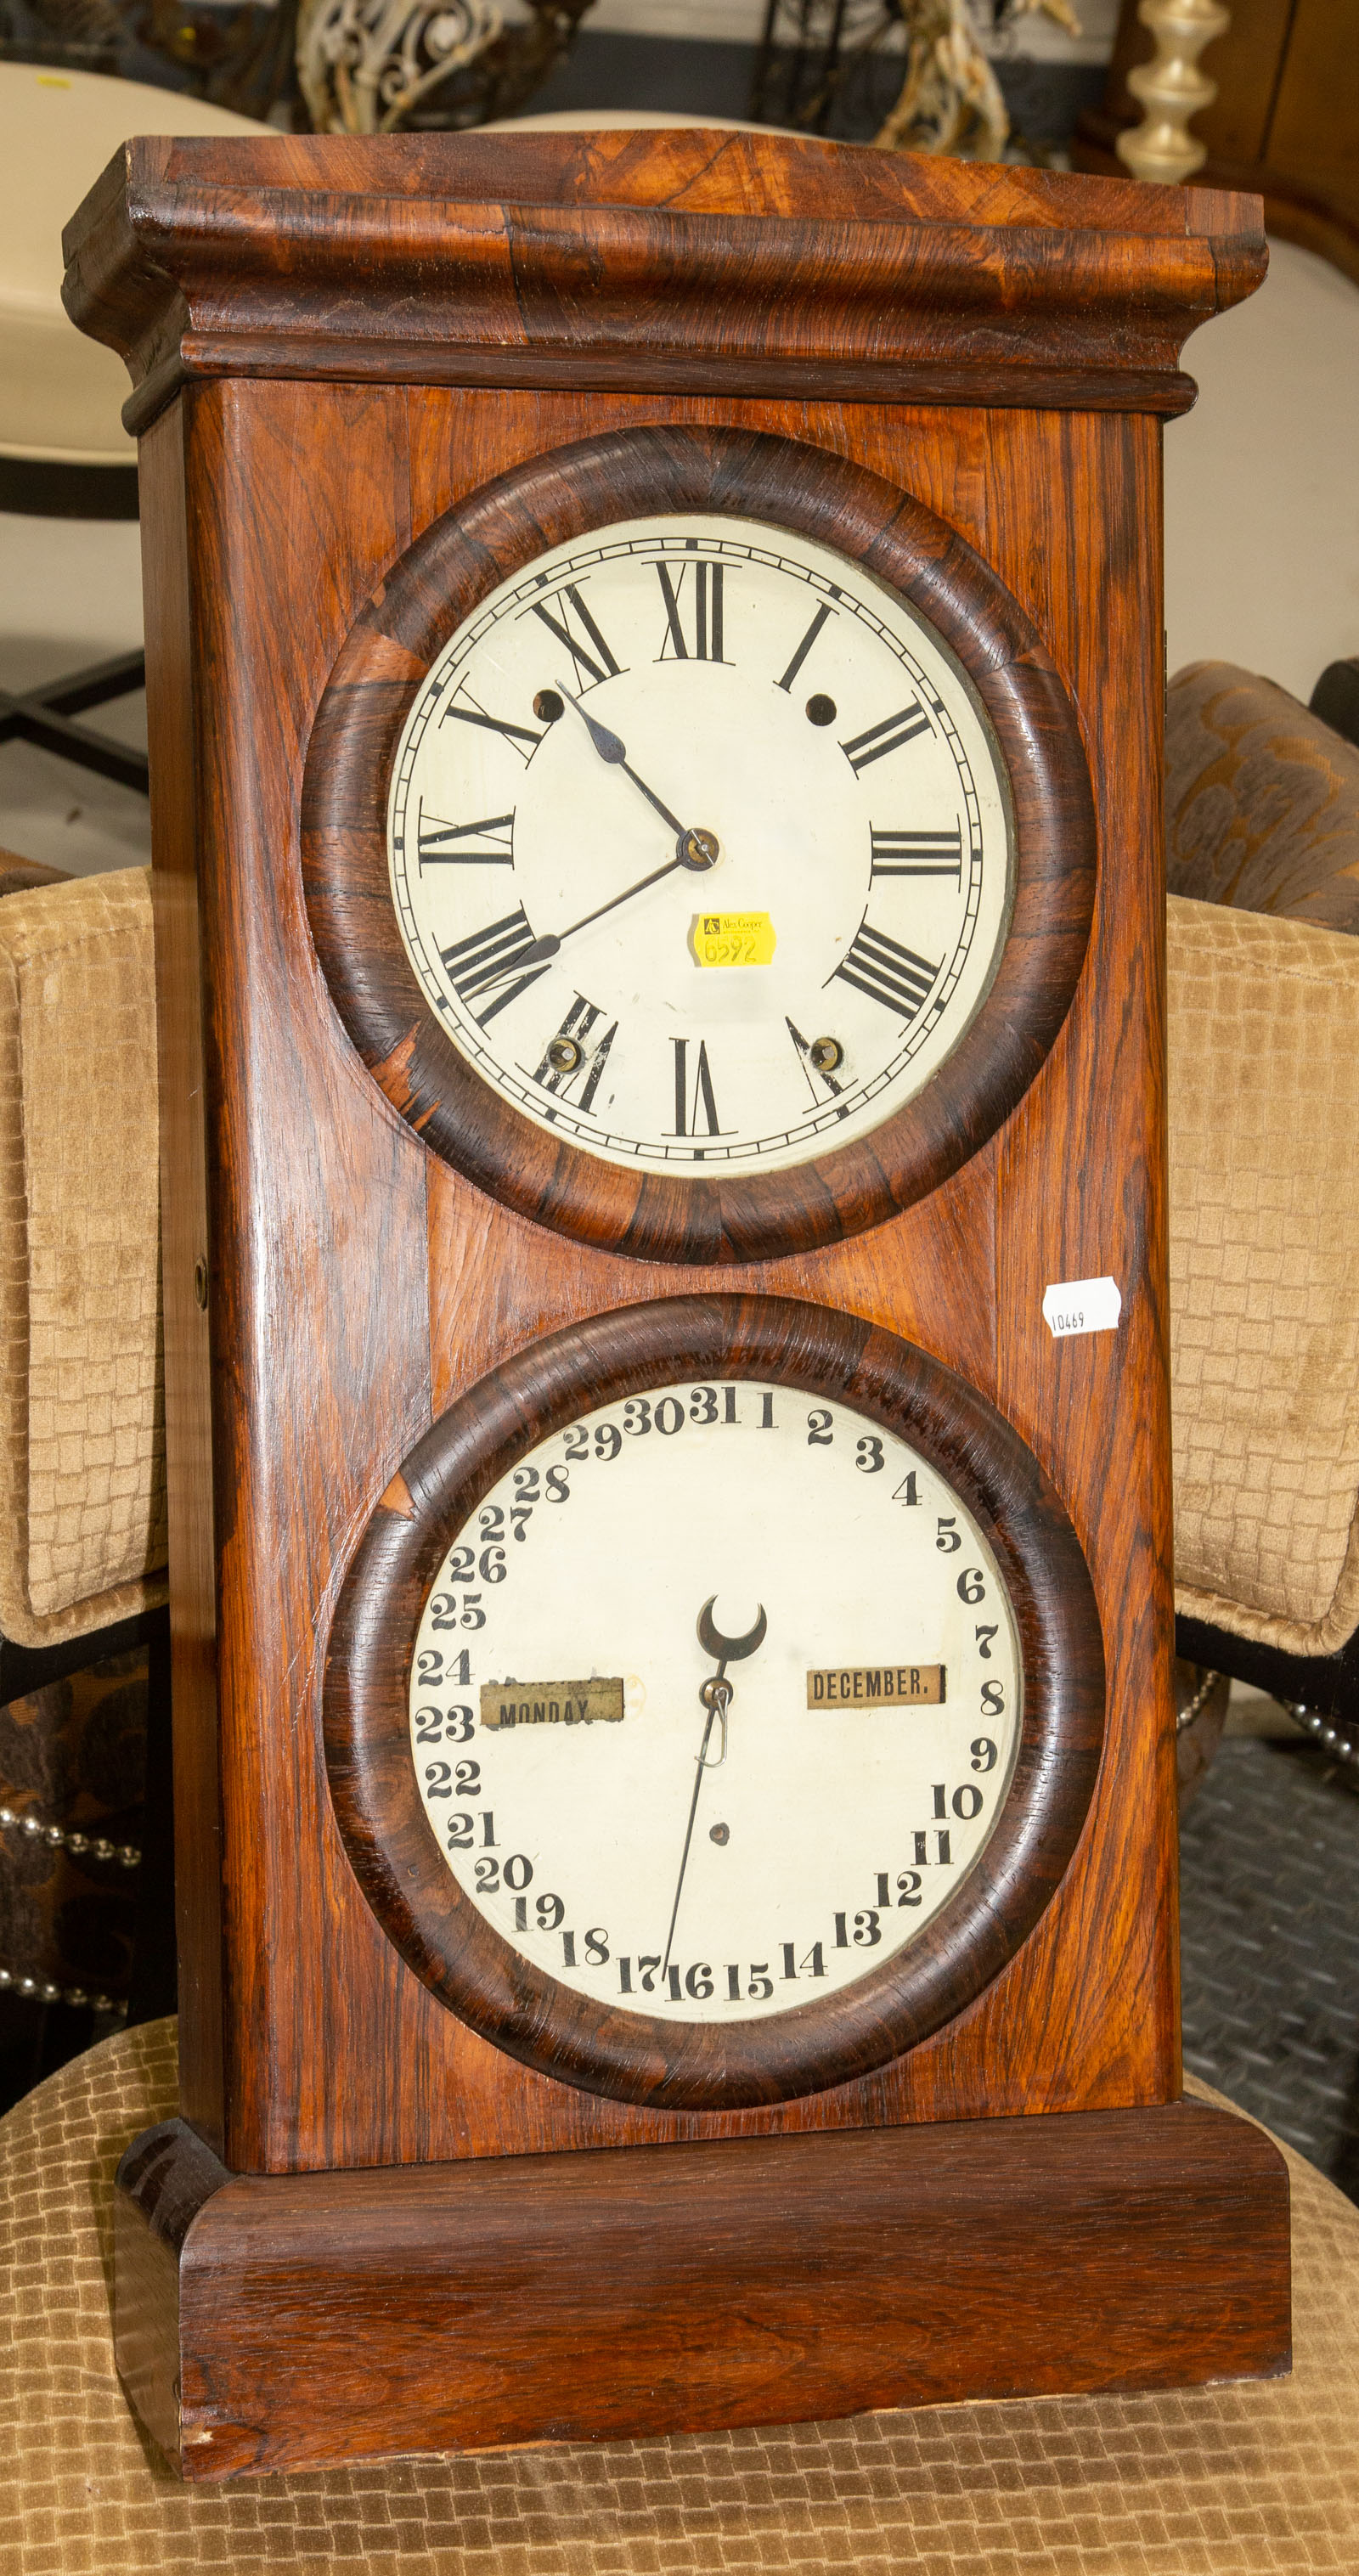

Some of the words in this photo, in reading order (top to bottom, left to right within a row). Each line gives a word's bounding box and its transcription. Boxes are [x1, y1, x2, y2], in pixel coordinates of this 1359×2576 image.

[641, 560, 742, 666] XII
[515, 576, 630, 700] XI
[773, 599, 839, 693] I
[438, 671, 554, 769] X
[837, 690, 937, 780] II
[417, 796, 516, 878] IX
[869, 813, 961, 893] III
[723, 918, 736, 929] Alex
[737, 917, 762, 931] Cooper
[705, 936, 756, 962] 6592
[431, 899, 552, 1040] VIII
[822, 904, 946, 1038] IIII
[515, 989, 618, 1117] VII
[785, 1016, 859, 1114] V
[661, 1037, 739, 1138] VI
[1052, 1312, 1084, 1332] 10469
[623, 1397, 685, 1435] 30
[690, 1387, 742, 1424] 31
[757, 1392, 779, 1429] 1
[563, 1423, 622, 1461] 29
[808, 1410, 833, 1445] 2
[856, 1436, 884, 1473] 3
[513, 1464, 570, 1502] 28
[892, 1471, 922, 1506] 4
[478, 1506, 533, 1542] 27
[936, 1518, 961, 1553] 5
[450, 1546, 506, 1583] 26
[957, 1568, 985, 1604] 6
[431, 1593, 486, 1630] 25
[975, 1625, 998, 1659] 7
[418, 1649, 475, 1686] 24
[813, 1668, 928, 1699] DECEMBER.
[499, 1699, 589, 1725] MONDAY
[980, 1680, 1005, 1716] 8
[415, 1705, 475, 1744] 23
[971, 1738, 997, 1773] 9
[426, 1761, 481, 1798] 22
[931, 1784, 983, 1819] 10
[448, 1812, 500, 1850] 21
[911, 1830, 954, 1865] 11
[475, 1855, 533, 1893] 20
[873, 1871, 922, 1908] 12
[510, 1893, 564, 1931] 19
[832, 1910, 881, 1948] 13
[561, 1928, 609, 1967] 18
[779, 1942, 827, 1979] 14
[616, 1955, 661, 1993] 17
[664, 1962, 713, 2002] 16
[724, 1964, 773, 2001] 15
